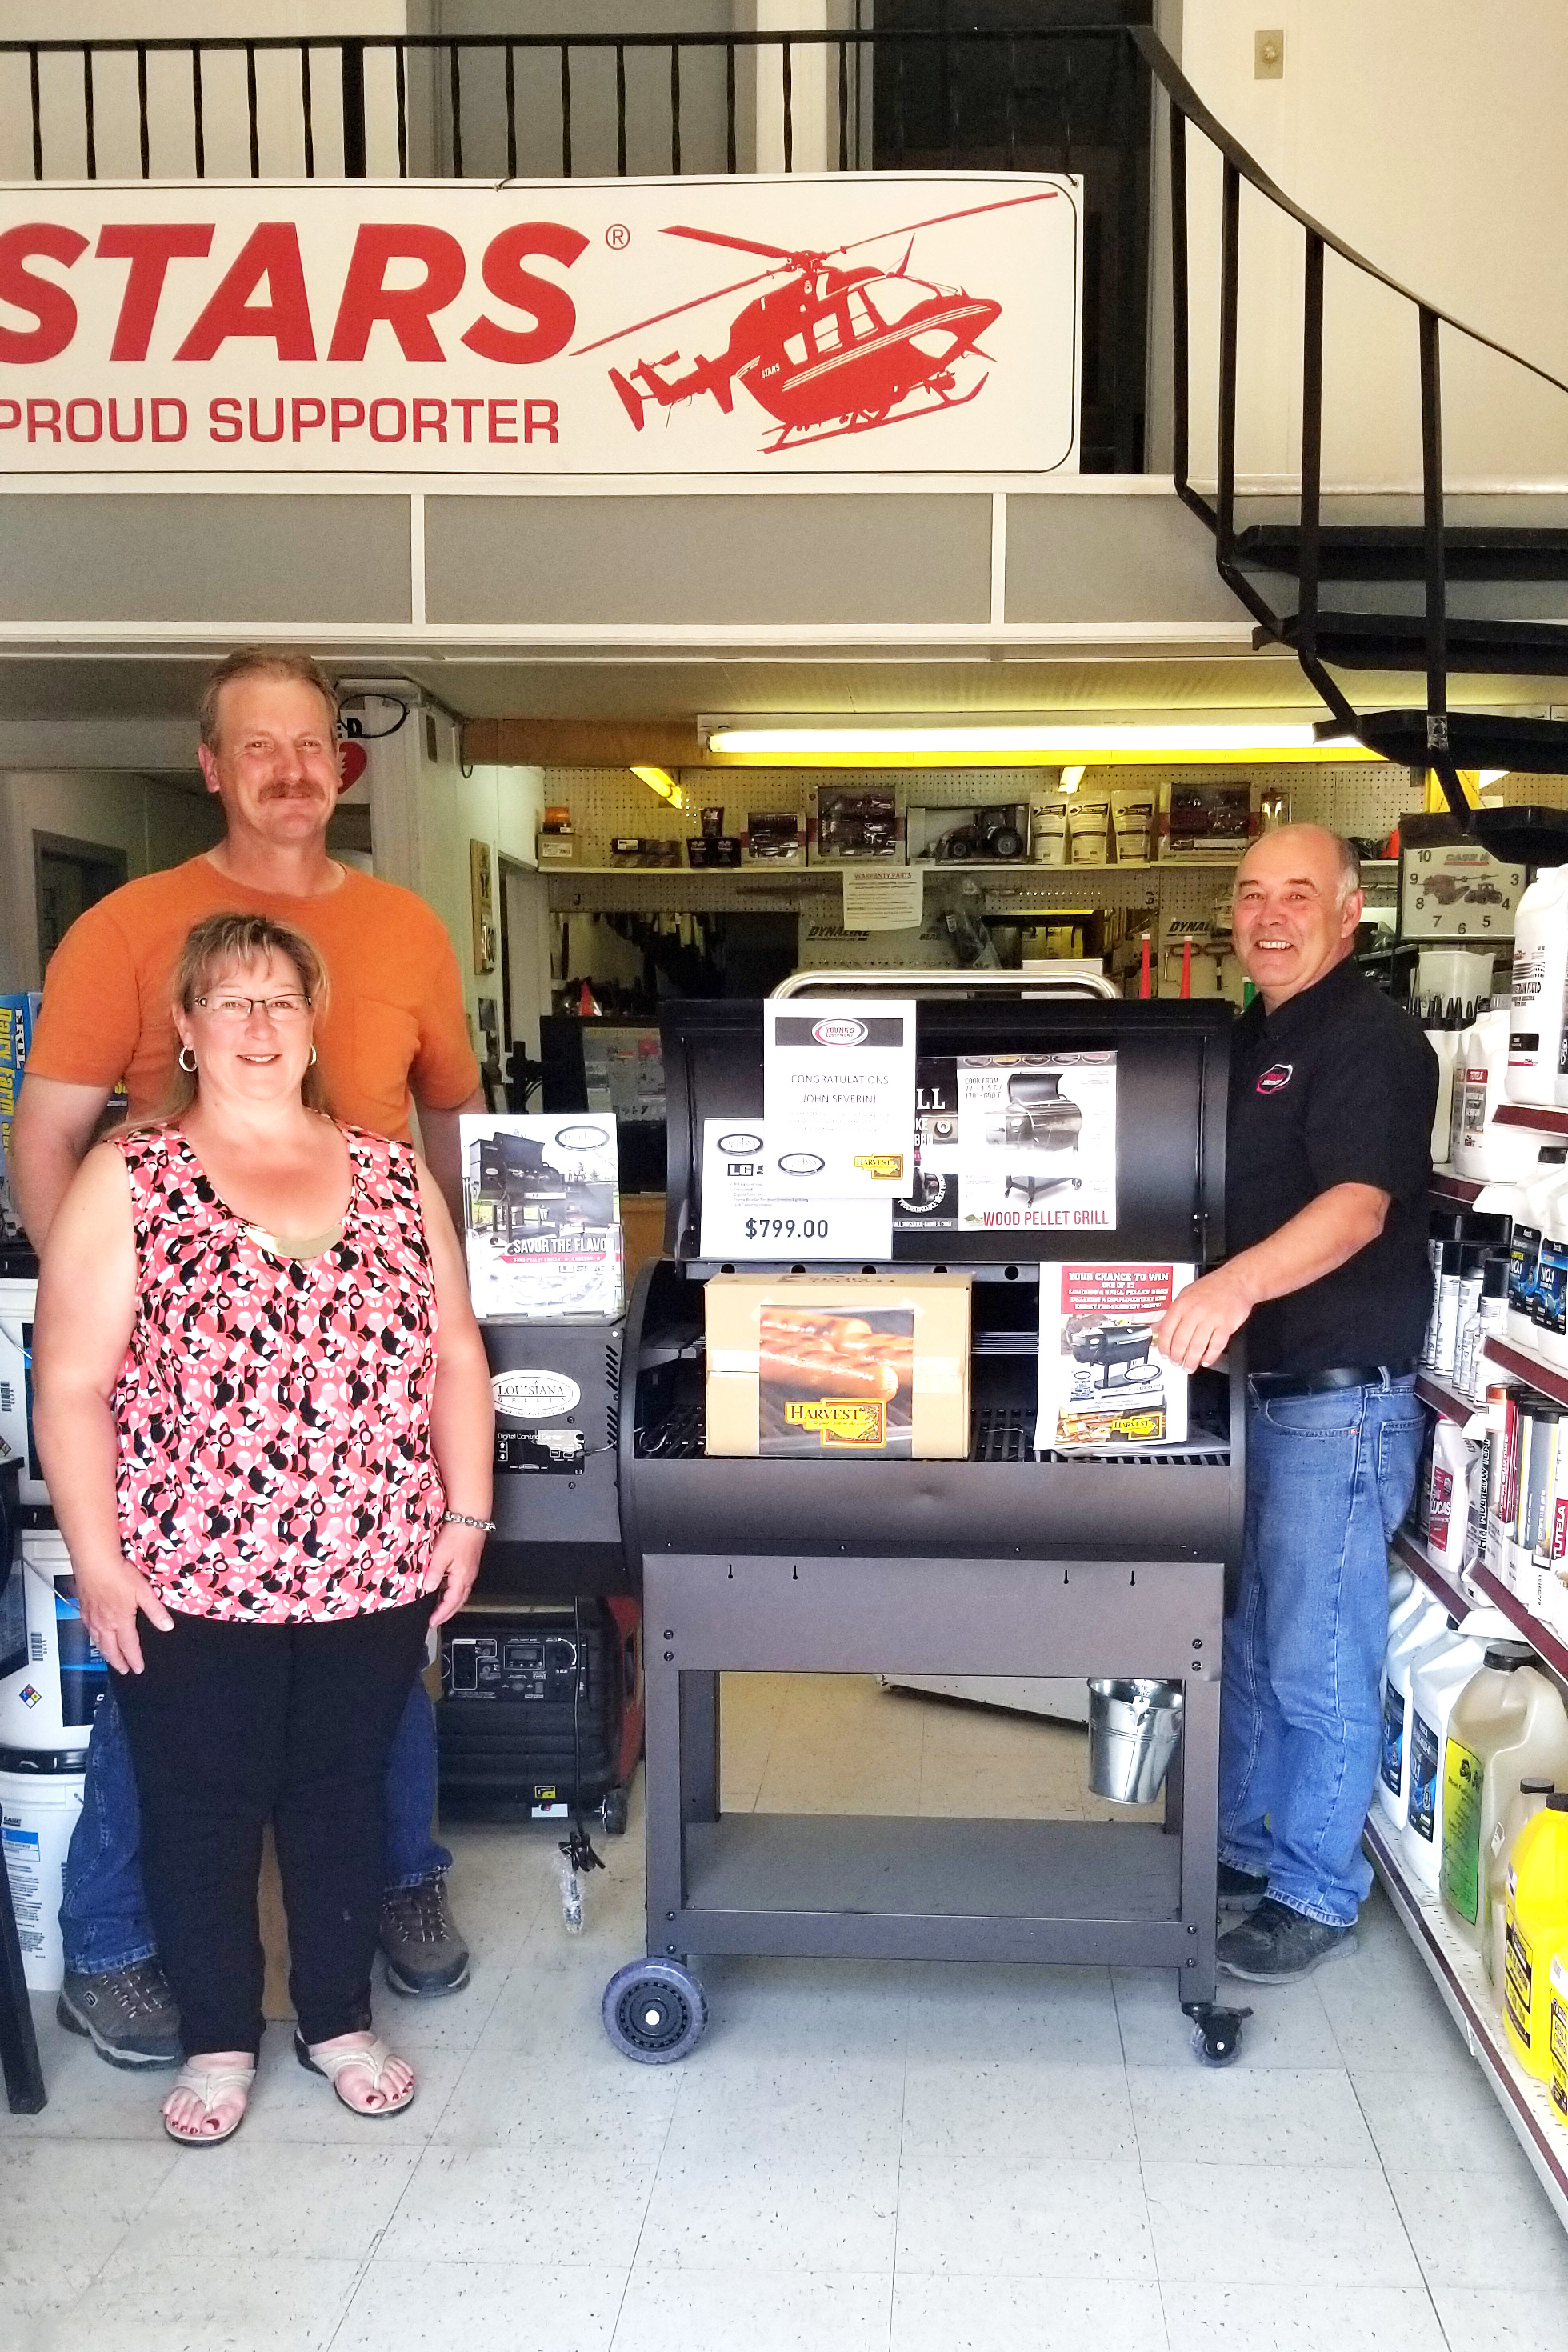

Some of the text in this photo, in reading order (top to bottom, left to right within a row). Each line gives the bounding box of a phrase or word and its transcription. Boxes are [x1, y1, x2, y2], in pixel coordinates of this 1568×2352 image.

[0, 222, 591, 364] STARS
[0, 397, 559, 444] PROUD SUPPORTER
[1418, 850, 1432, 862] 10
[854, 872, 890, 880] WARRANTY
[1410, 874, 1418, 884] 9
[1510, 874, 1519, 886] 3
[1415, 898, 1425, 910] 8
[1502, 898, 1510, 910] 4
[1433, 915, 1442, 927] 7
[1482, 915, 1491, 928] 5
[1458, 922, 1467, 934] 6
[791, 1074, 889, 1085] CONGRATULATIONS
[802, 1094, 877, 1104] JOHN SEVERIN!
[856, 1157, 891, 1166] HARVEST
[983, 1210, 1109, 1226] WOOD PELLET GRILL
[745, 1217, 829, 1240] $799.00
[513, 1238, 550, 1254] SAVOR
[551, 1238, 573, 1253] THE
[1068, 1272, 1169, 1282] YOUR CHANCE TO WIN
[498, 1385, 564, 1395] LOUISIANA
[790, 1405, 858, 1420] HARVEST
[1114, 1419, 1150, 1429] HARVEST
[498, 1433, 516, 1441] Digital
[1430, 1499, 1452, 1516] LUCAS
[1554, 1504, 1566, 1559] TUTELA
